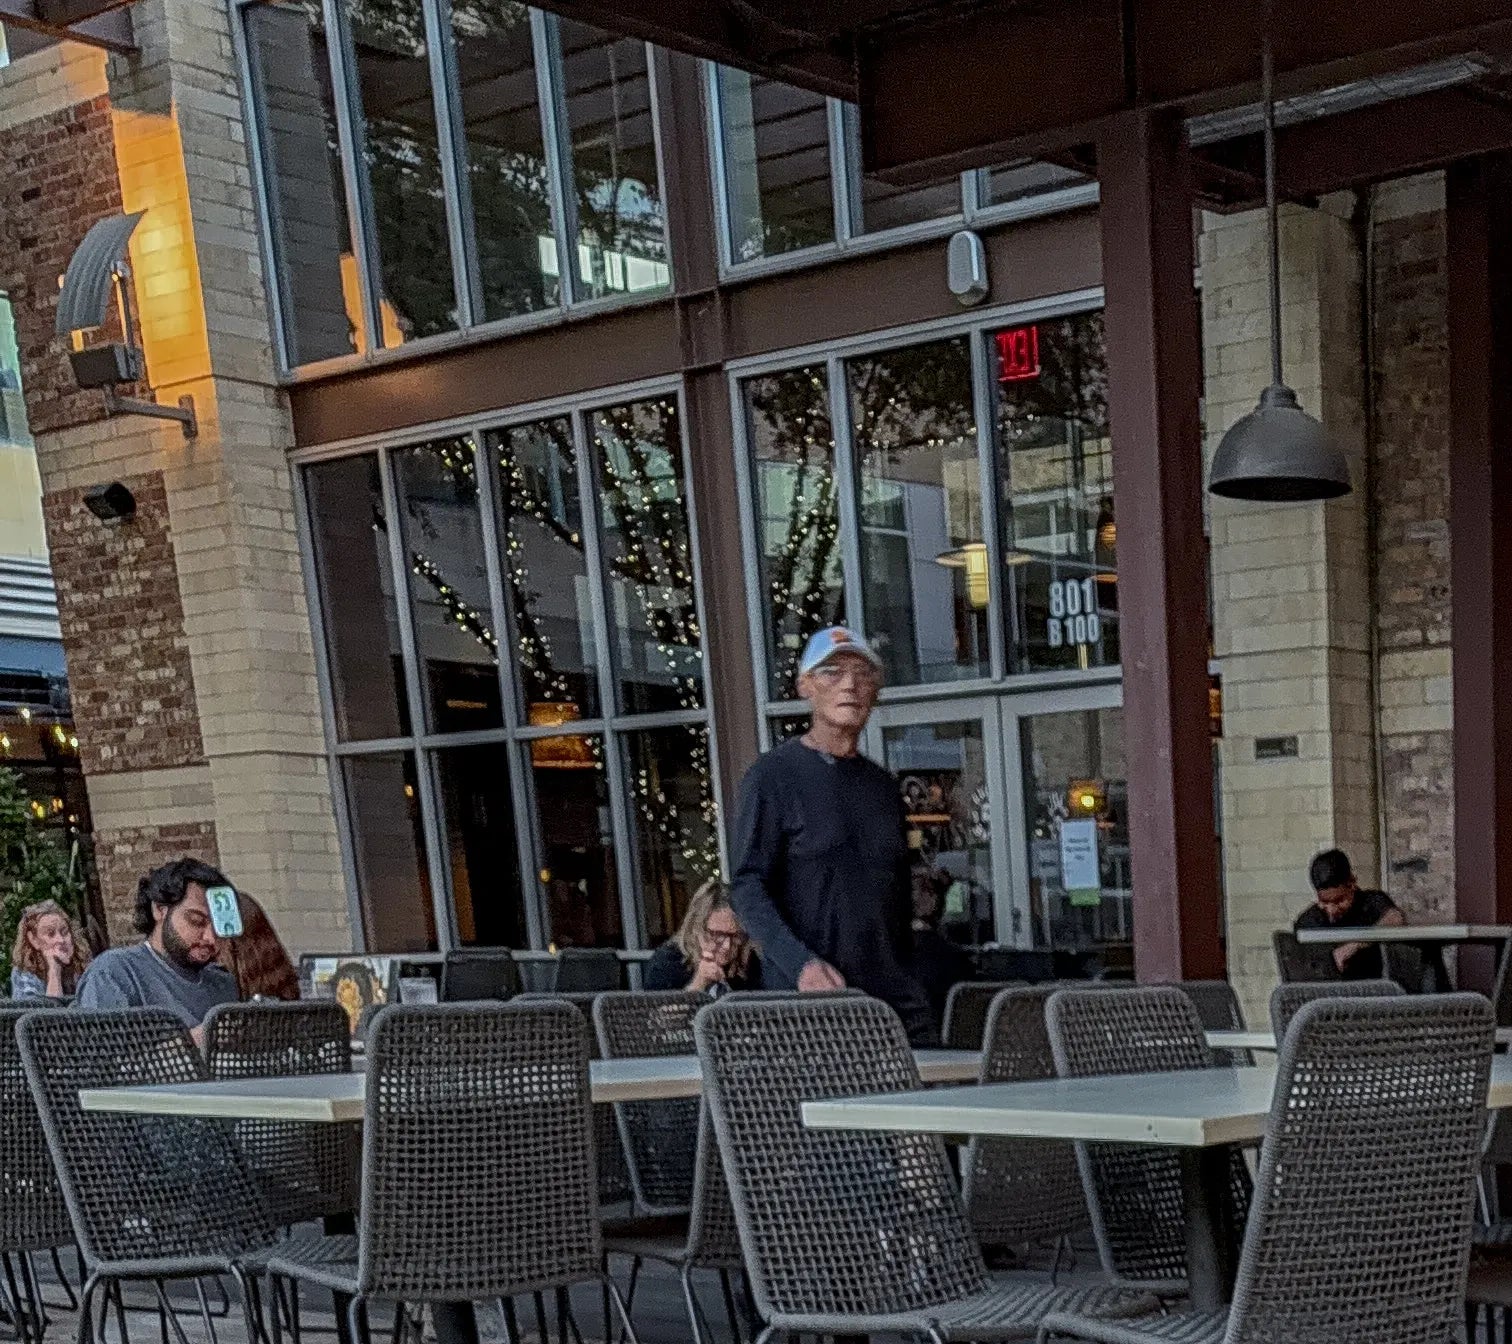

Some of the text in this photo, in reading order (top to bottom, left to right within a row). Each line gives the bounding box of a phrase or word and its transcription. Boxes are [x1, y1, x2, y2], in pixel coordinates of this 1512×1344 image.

[1048, 578, 1094, 618] 801
[1047, 613, 1101, 647] B 100
